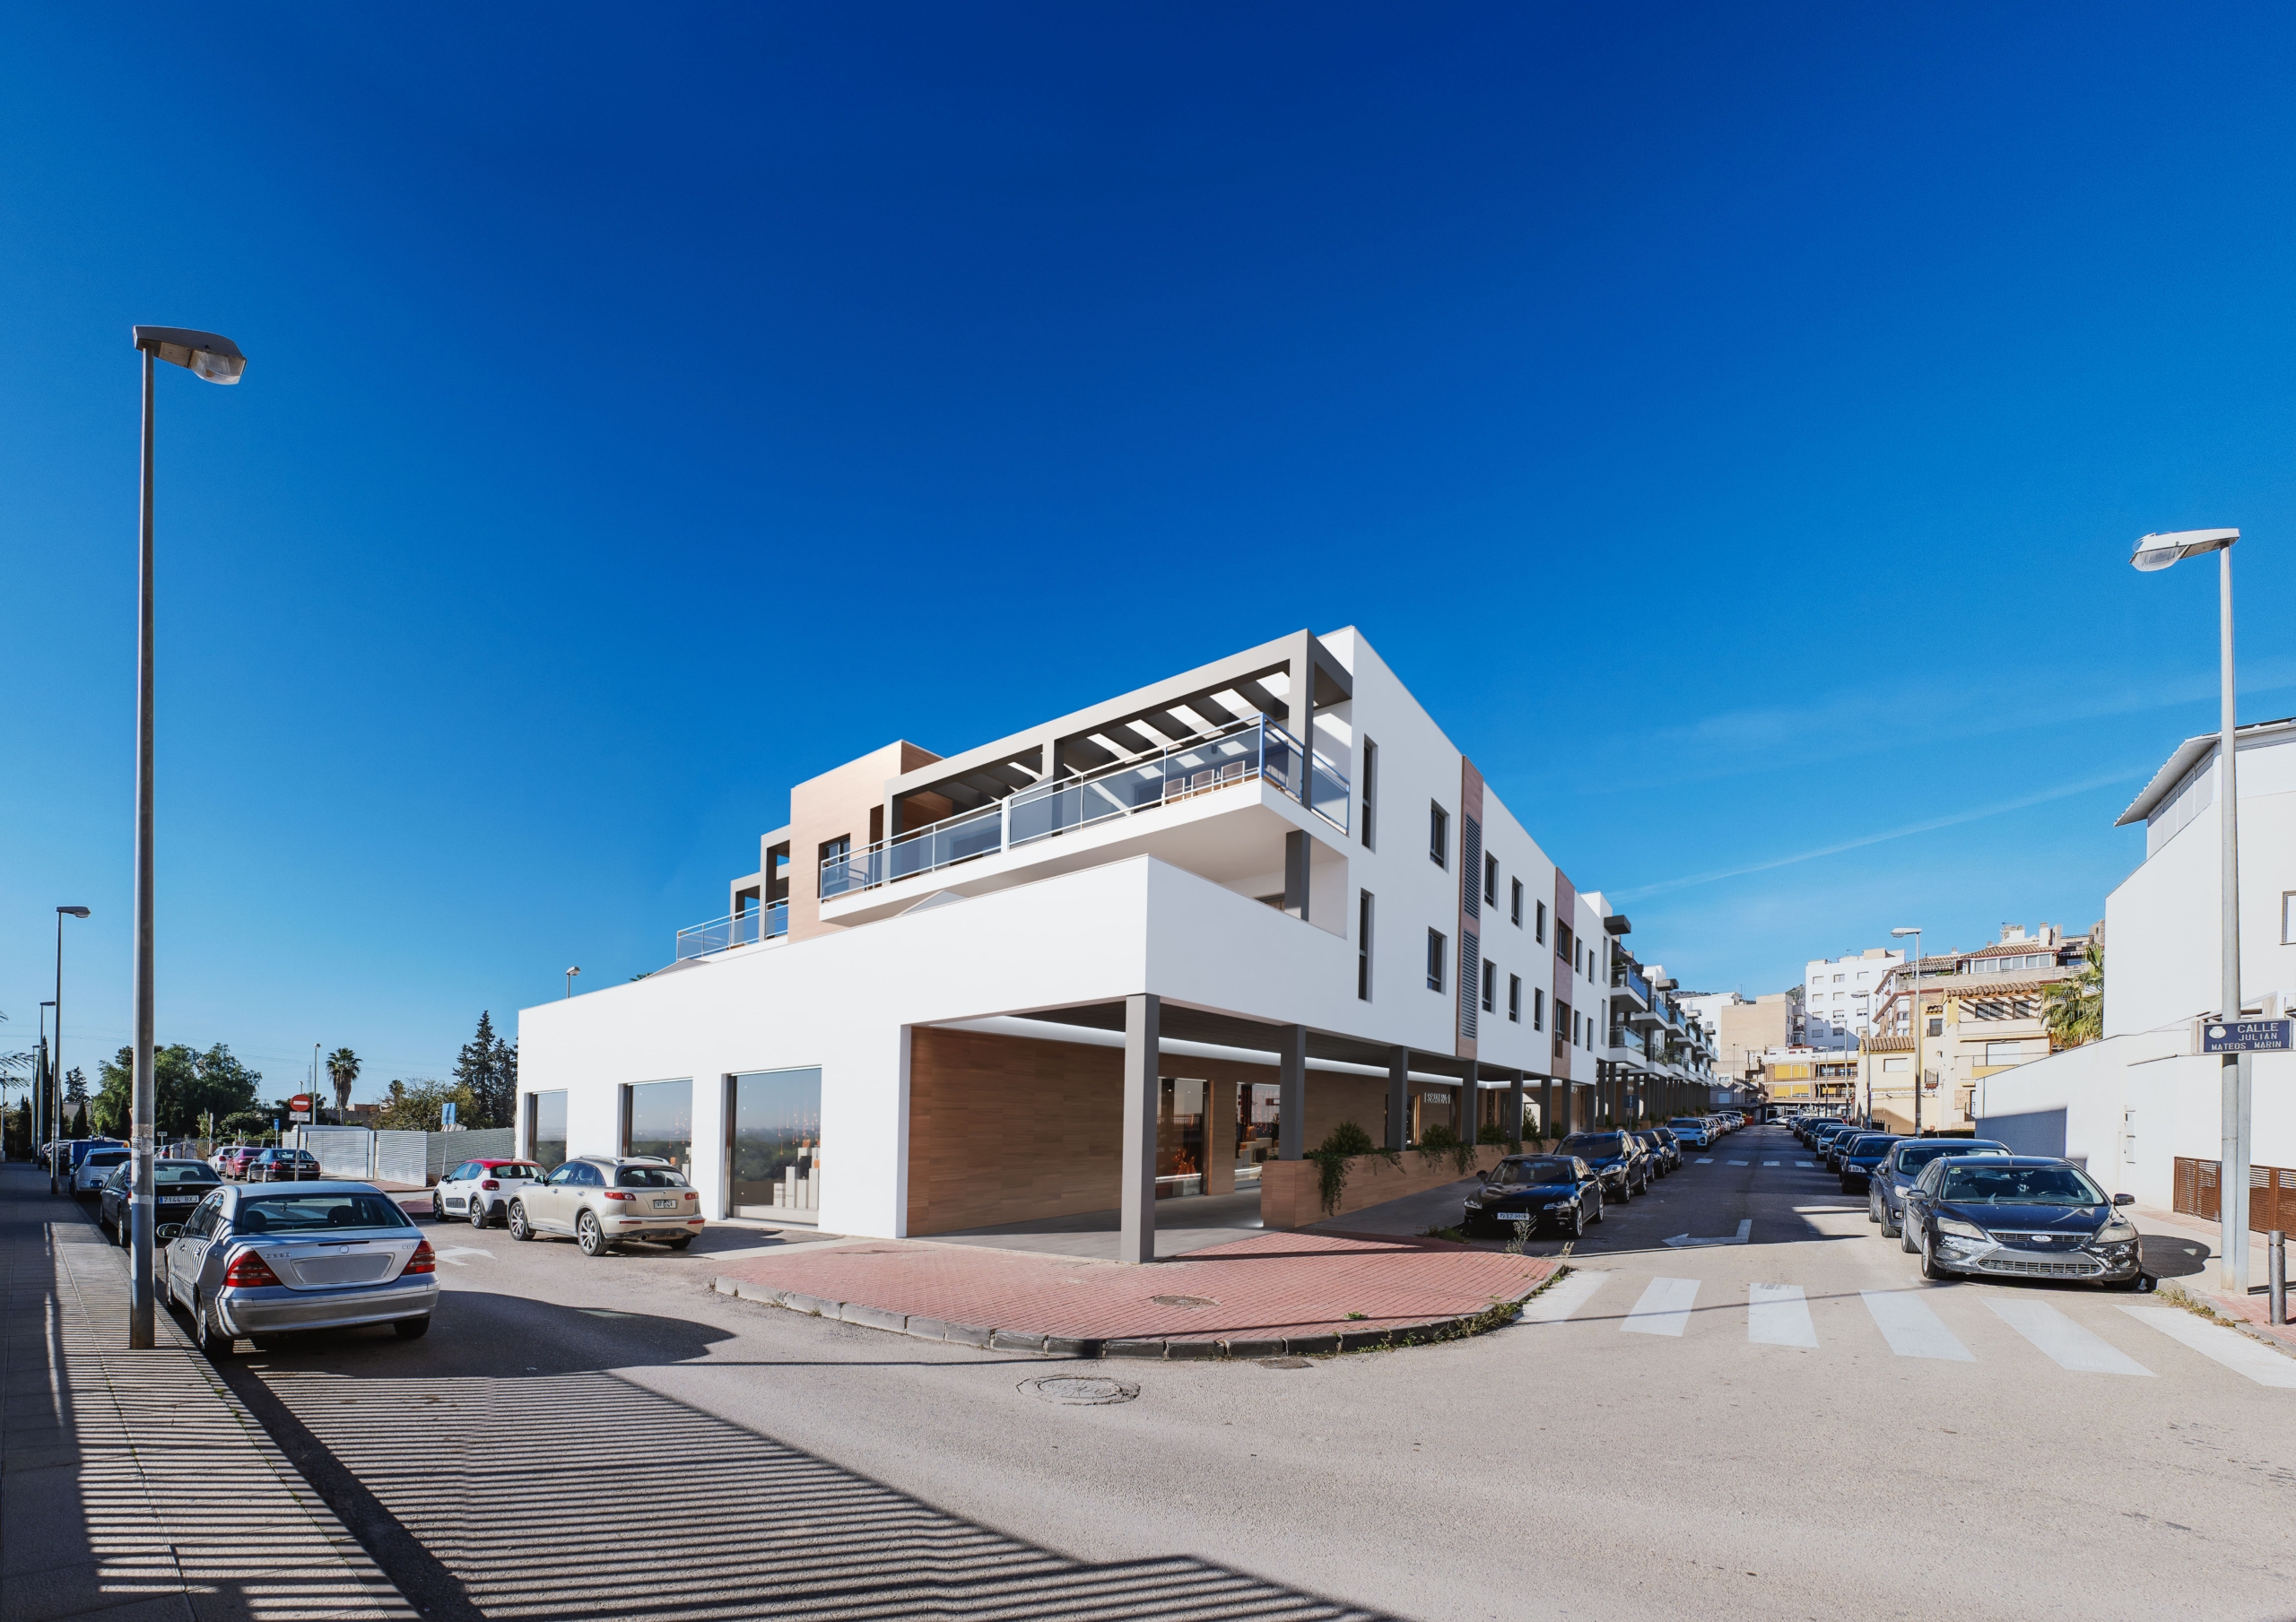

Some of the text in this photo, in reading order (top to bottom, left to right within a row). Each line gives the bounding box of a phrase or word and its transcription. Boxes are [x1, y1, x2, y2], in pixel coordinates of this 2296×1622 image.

[2237, 1022, 2279, 1033] CALLE
[2239, 1032, 2278, 1041] JULIAN
[2211, 1040, 2282, 1051] MATEOS MARIN
